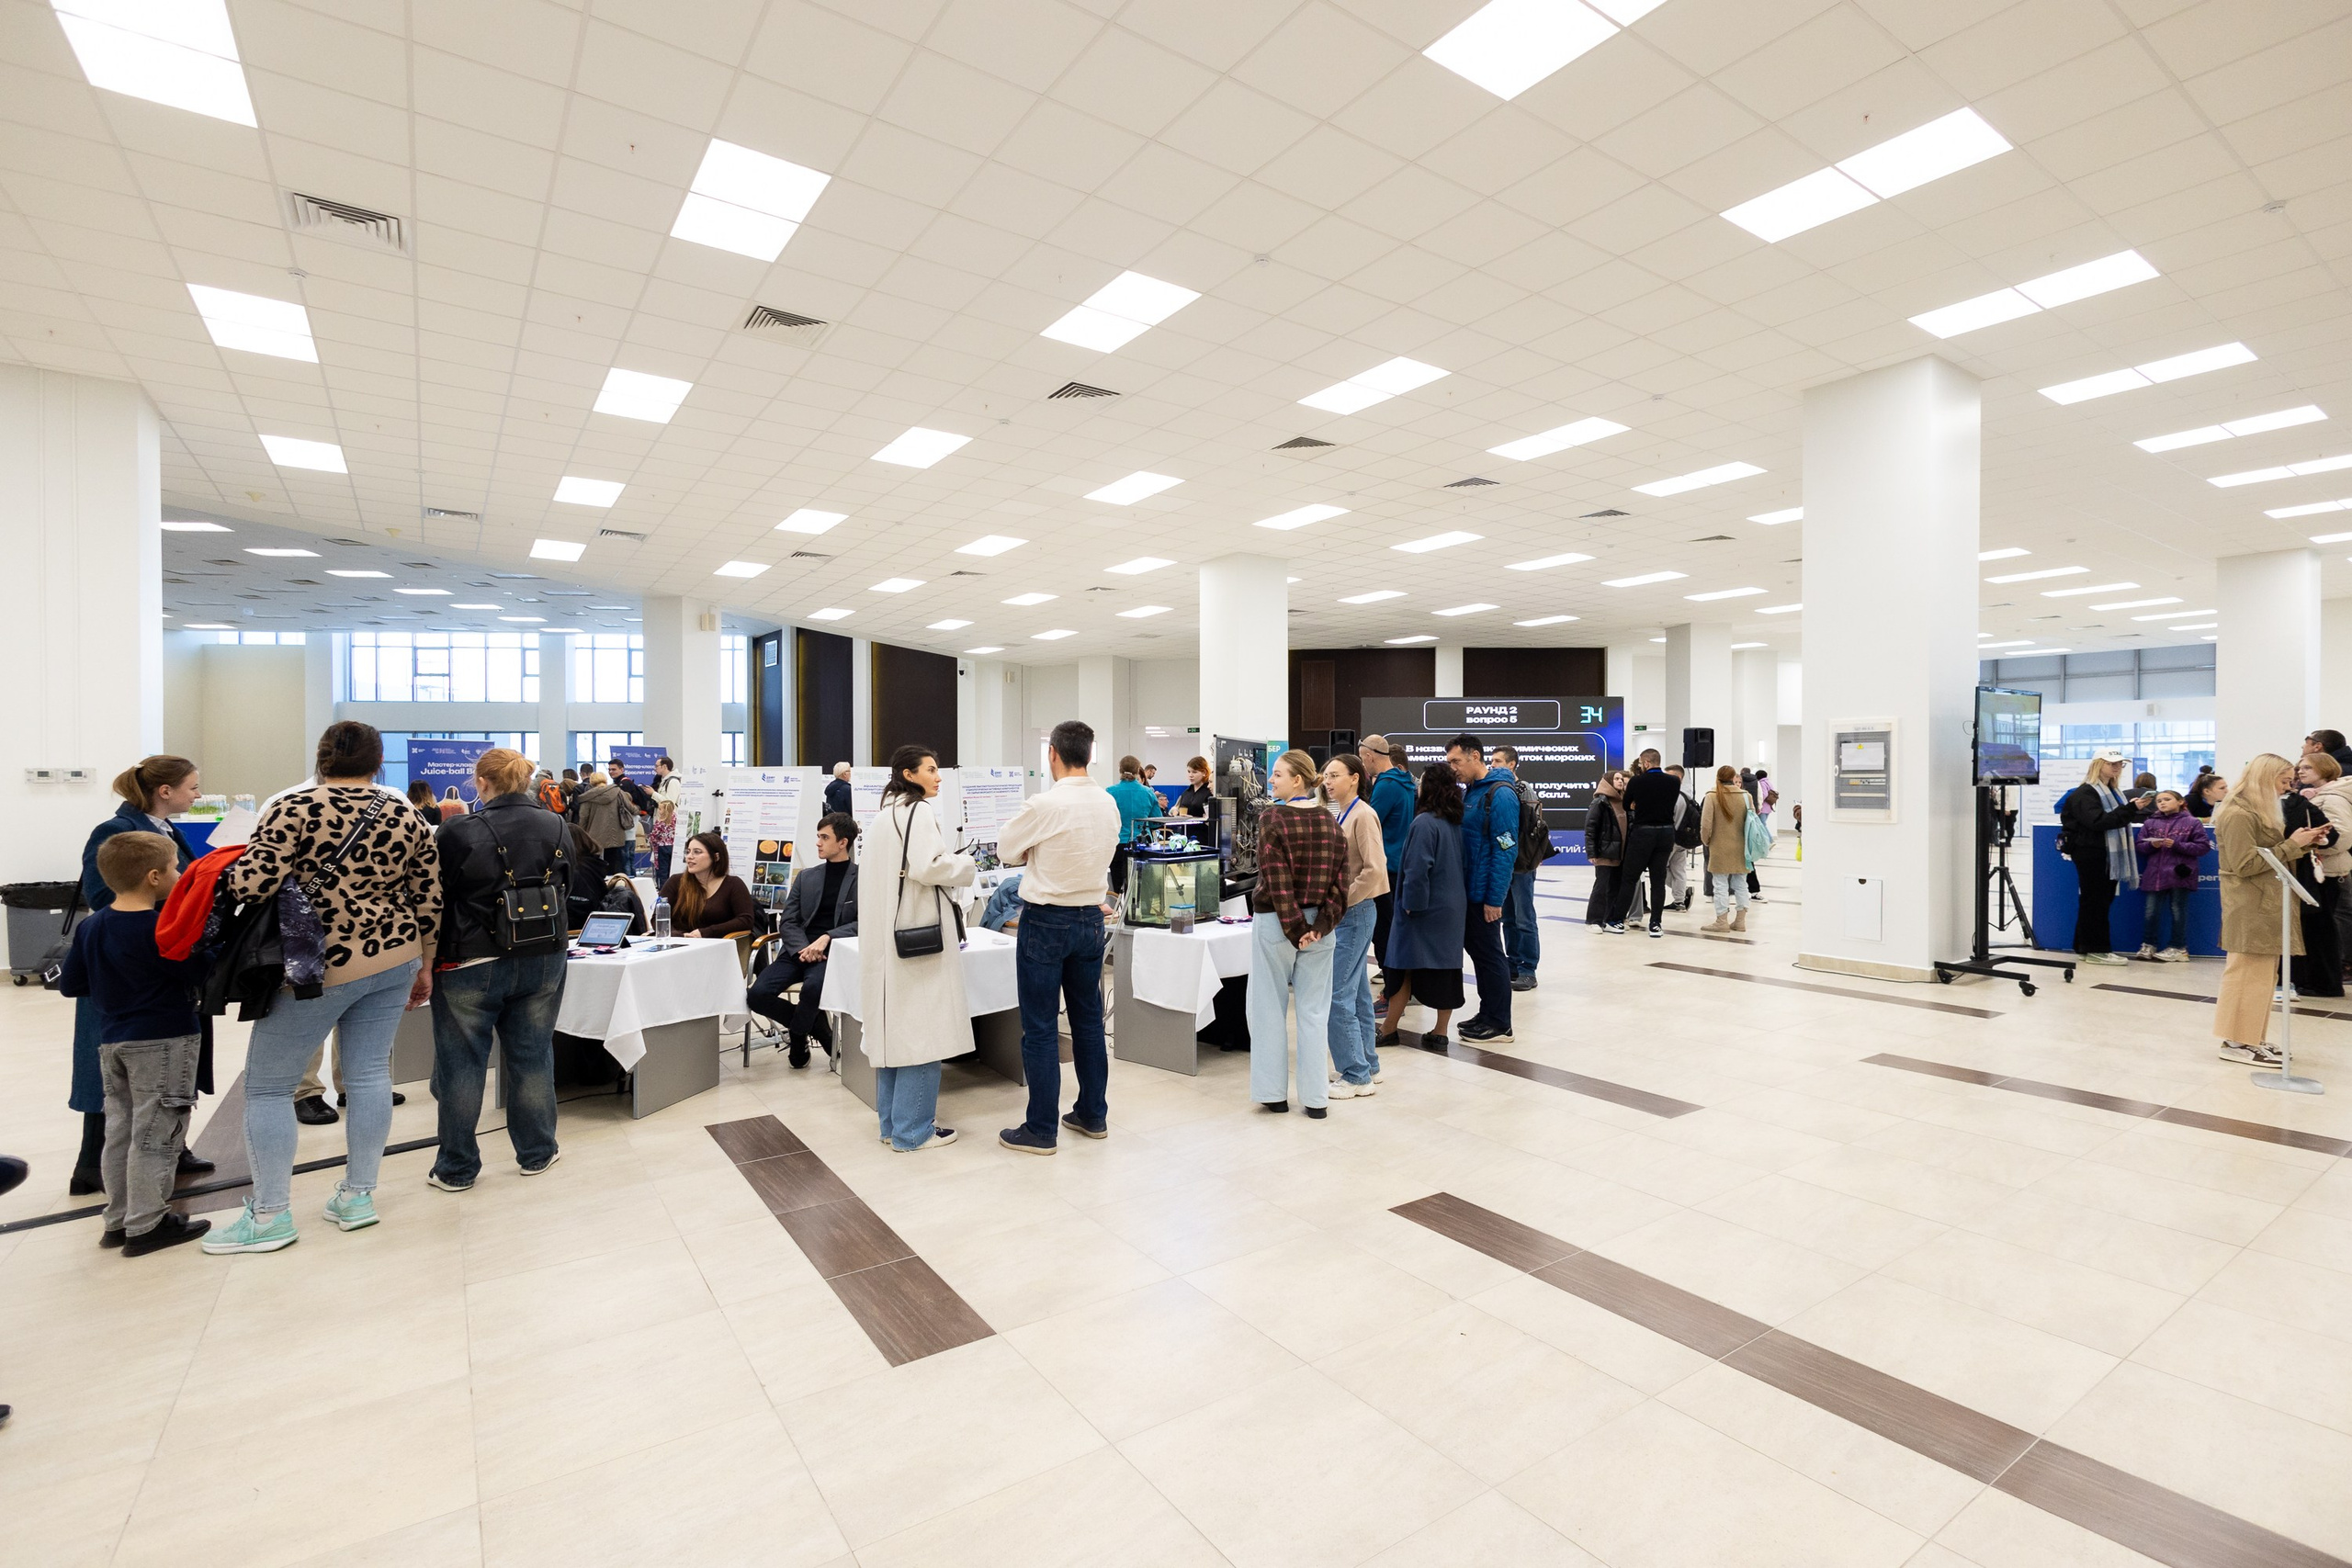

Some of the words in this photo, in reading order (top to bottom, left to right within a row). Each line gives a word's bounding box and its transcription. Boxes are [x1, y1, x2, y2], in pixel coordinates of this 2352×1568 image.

[1465, 706, 1508, 715] РАУНД
[1579, 705, 1603, 723] 34
[1465, 716, 1509, 724] вопрос
[1509, 715, 1518, 724] 5
[1544, 754, 1596, 762] морских
[1590, 781, 1597, 789] 1
[1538, 790, 1571, 798] балл.
